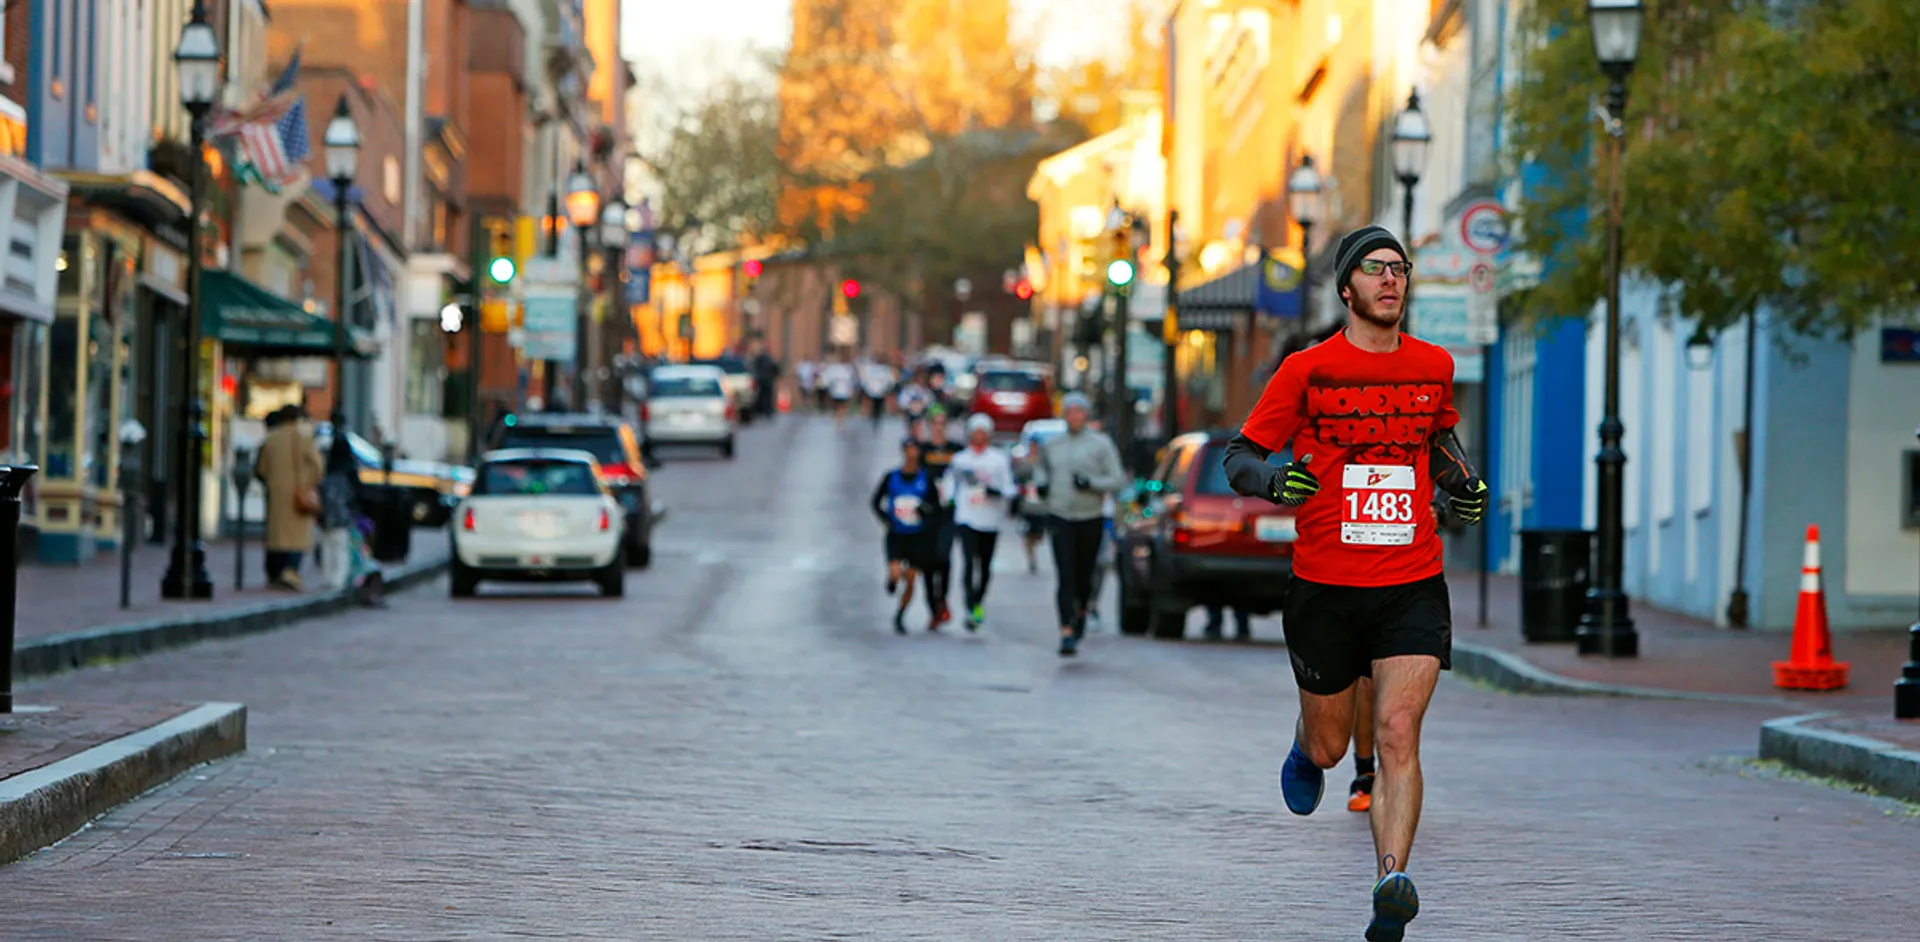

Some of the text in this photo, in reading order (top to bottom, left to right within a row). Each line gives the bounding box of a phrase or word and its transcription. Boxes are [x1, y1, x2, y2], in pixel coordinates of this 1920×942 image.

[1307, 384, 1442, 416] NOVEMBER
[1317, 416, 1434, 445] PROJECT
[1345, 491, 1413, 522] 1483
